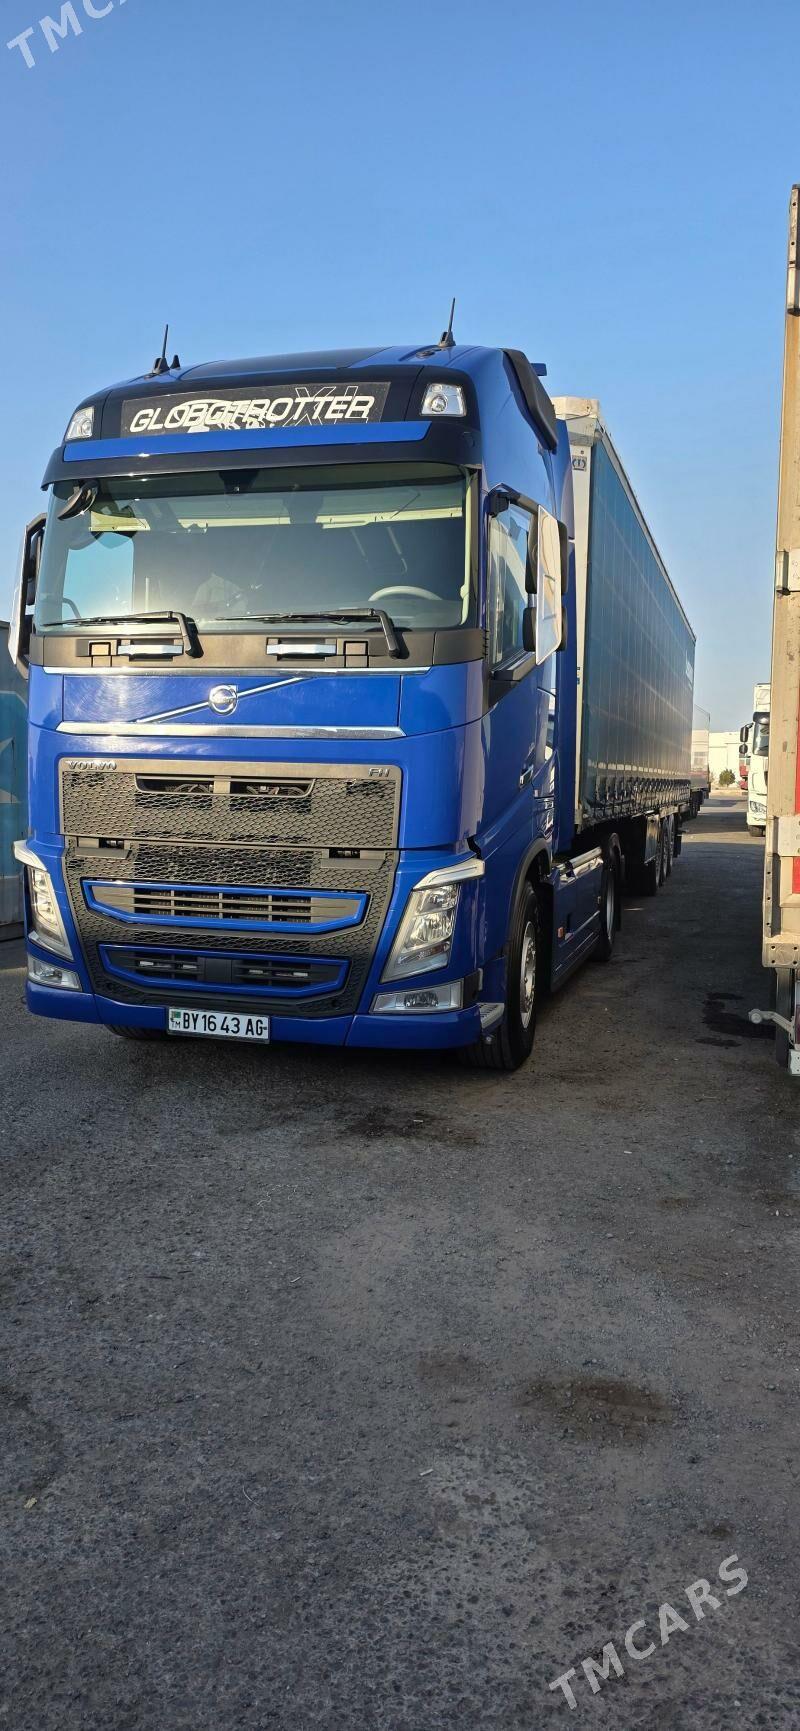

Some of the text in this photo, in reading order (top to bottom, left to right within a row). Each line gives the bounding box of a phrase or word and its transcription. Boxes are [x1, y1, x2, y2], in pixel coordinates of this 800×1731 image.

[129, 395, 375, 433] GLOBOTROTTER
[65, 760, 117, 771] VOLVO
[220, 1016, 241, 1034] 43
[245, 1018, 264, 1036] AG
